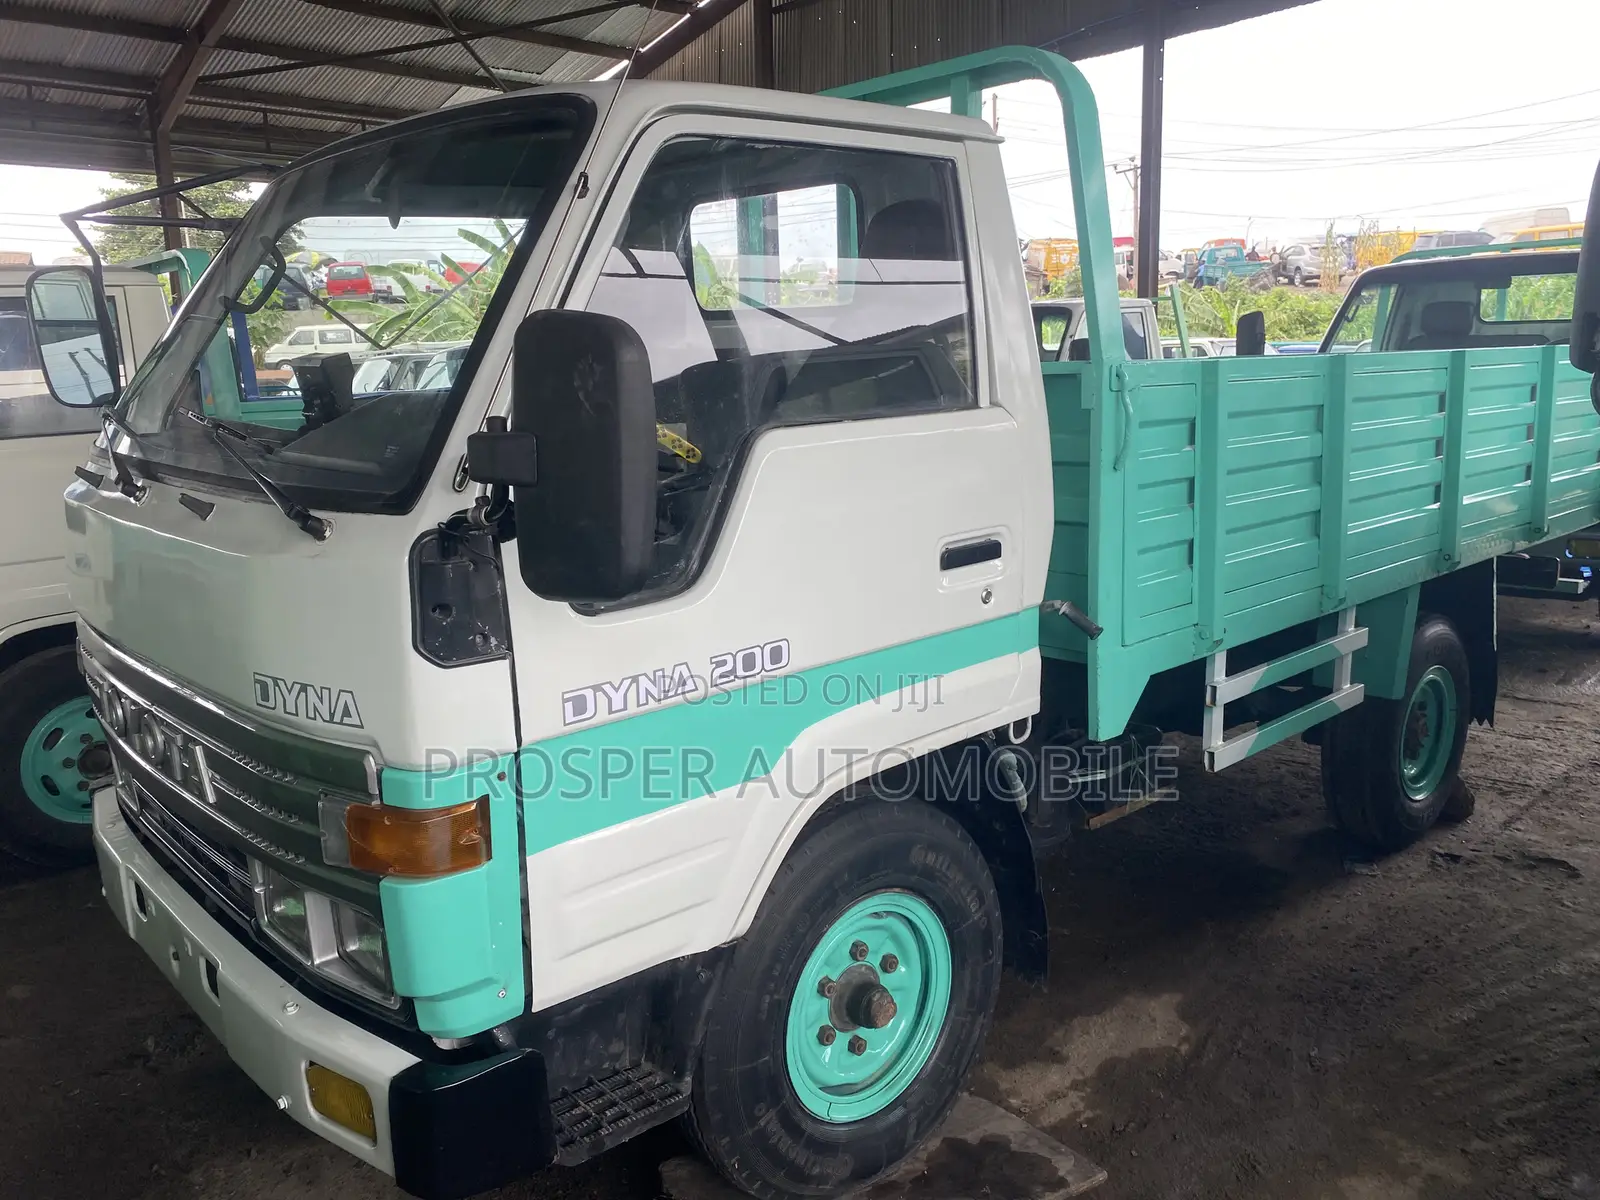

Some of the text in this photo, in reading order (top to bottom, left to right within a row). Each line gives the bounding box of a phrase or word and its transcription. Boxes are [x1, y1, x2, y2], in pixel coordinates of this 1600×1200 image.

[252, 671, 365, 729] DYNA
[561, 637, 791, 727] DYNA 200
[94, 673, 218, 805] TOYOTA
